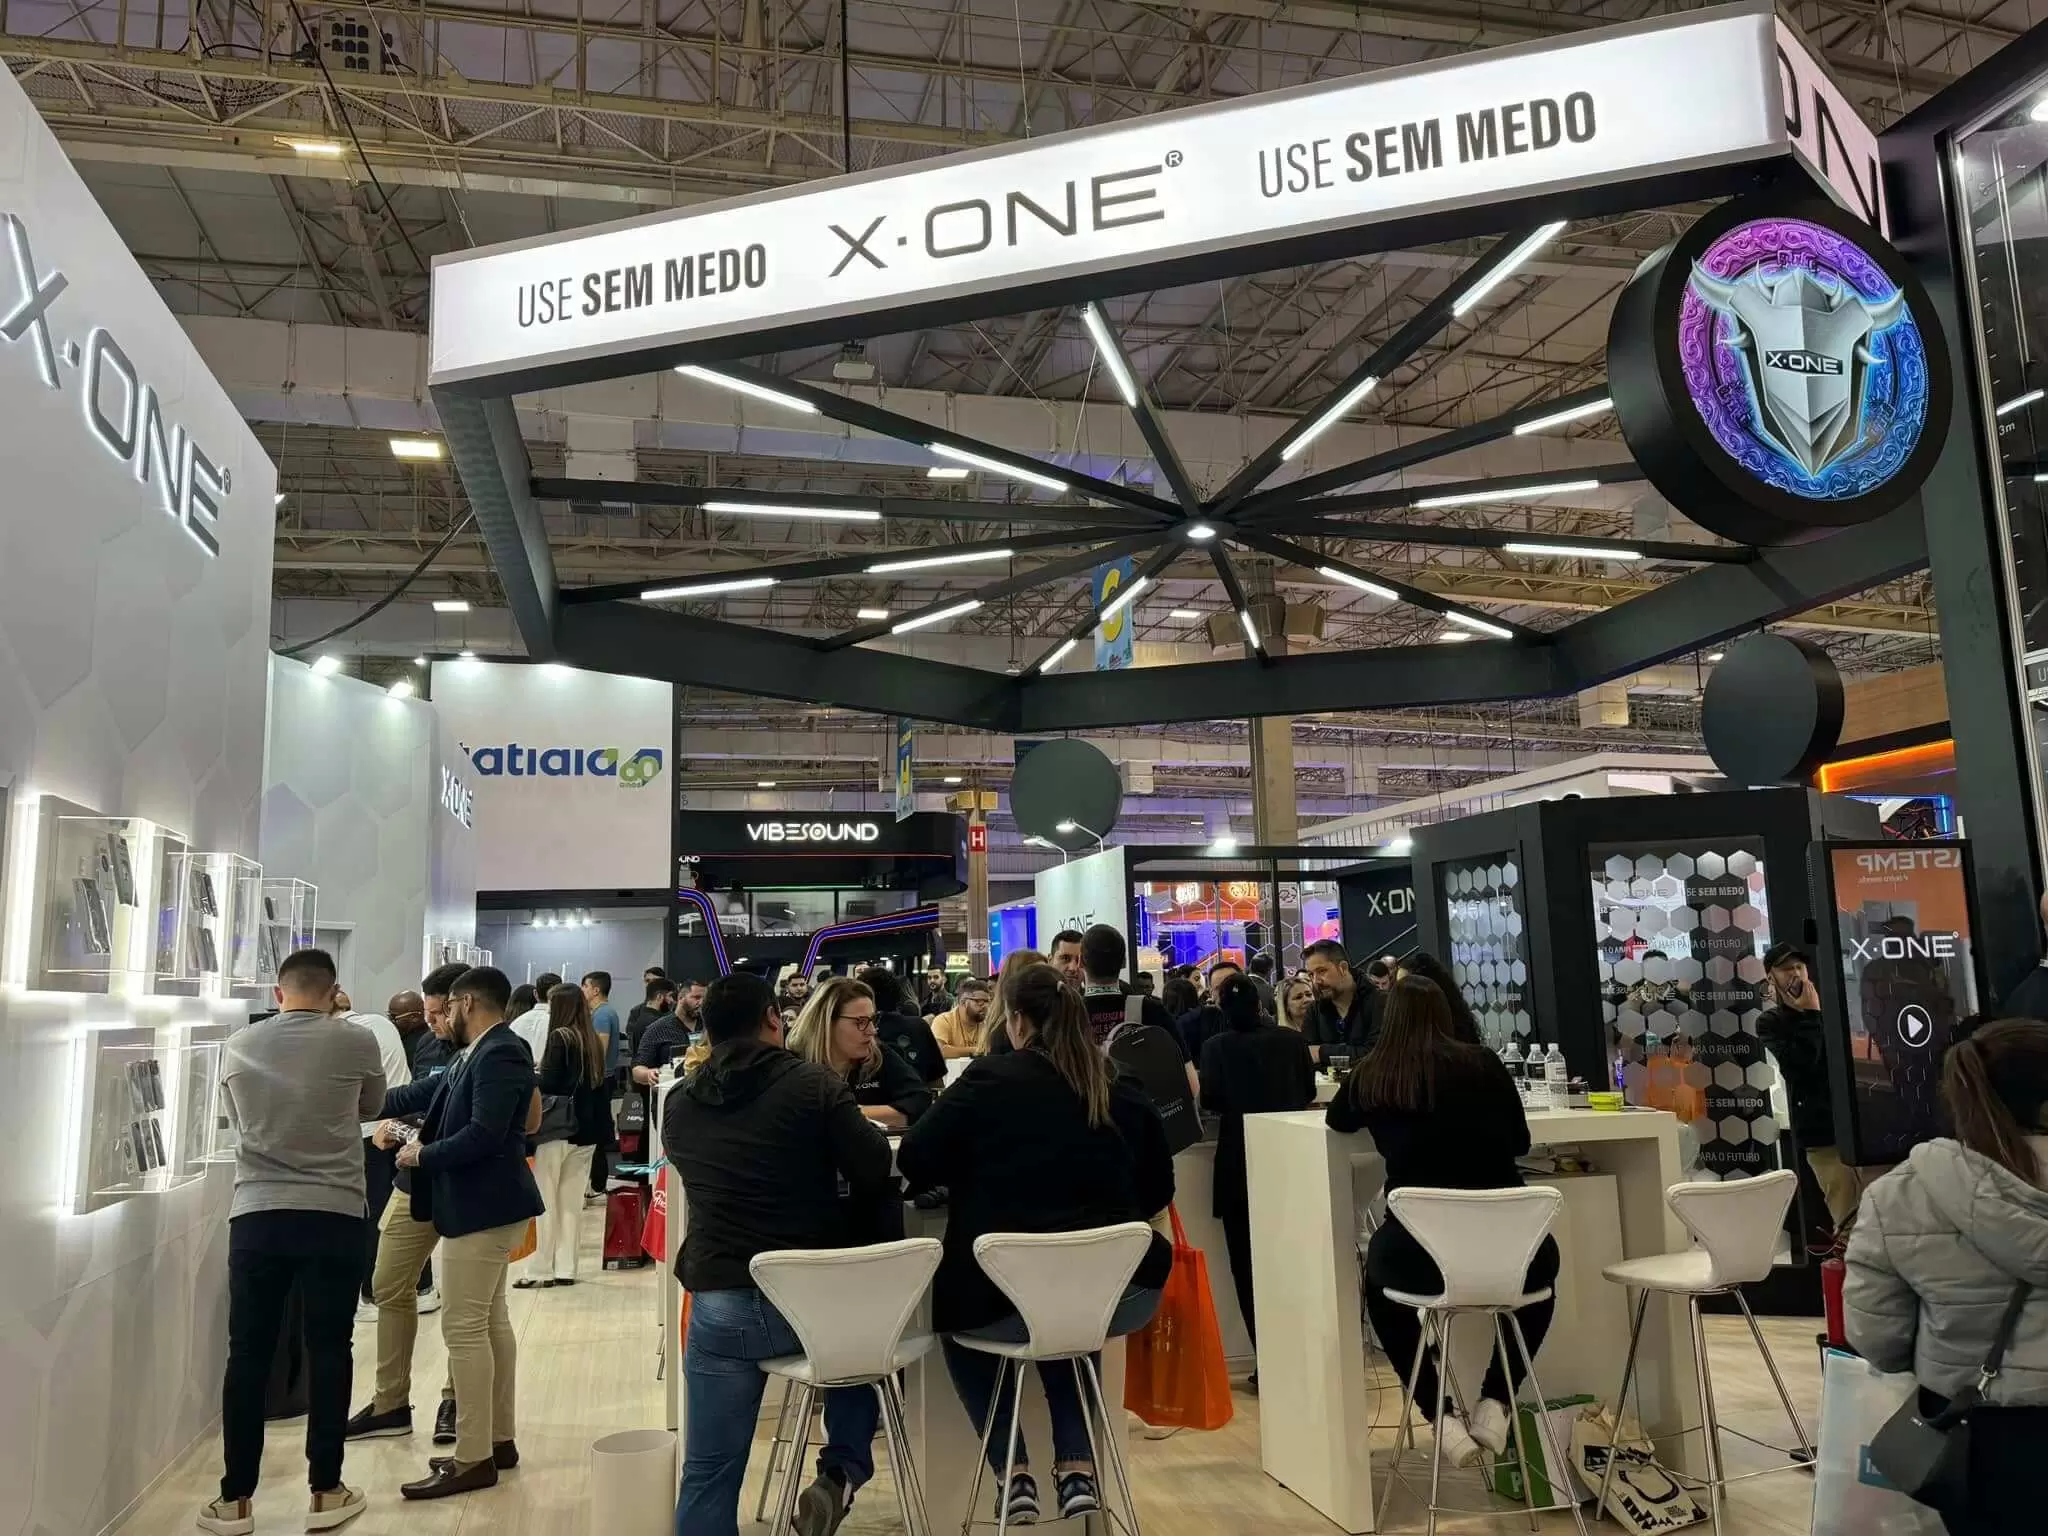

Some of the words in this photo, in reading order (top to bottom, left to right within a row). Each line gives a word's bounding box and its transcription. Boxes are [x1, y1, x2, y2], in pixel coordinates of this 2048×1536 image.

[1259, 138, 1334, 198] USE
[1345, 117, 1443, 183] SEM
[1455, 90, 1597, 164] MEDO
[518, 277, 573, 328] USE
[581, 262, 653, 317] SEM
[664, 243, 767, 303] MEDO
[460, 742, 619, 776] atiaia
[619, 754, 661, 783] 60
[746, 822, 880, 842] VIBESOUND
[972, 833, 984, 847] H
[1698, 887, 1717, 897] SEM
[1719, 886, 1745, 896] MEDO
[1677, 939, 1699, 949] PAA
[1708, 939, 1740, 948] FUTURO
[1706, 991, 1726, 1001] SEM
[1728, 991, 1754, 1001] MEDO
[1717, 1044, 1750, 1053] FUTURO
[1716, 1098, 1735, 1107] SEM
[1737, 1098, 1764, 1107] MEDO
[1726, 1152, 1760, 1162] FUTURO
